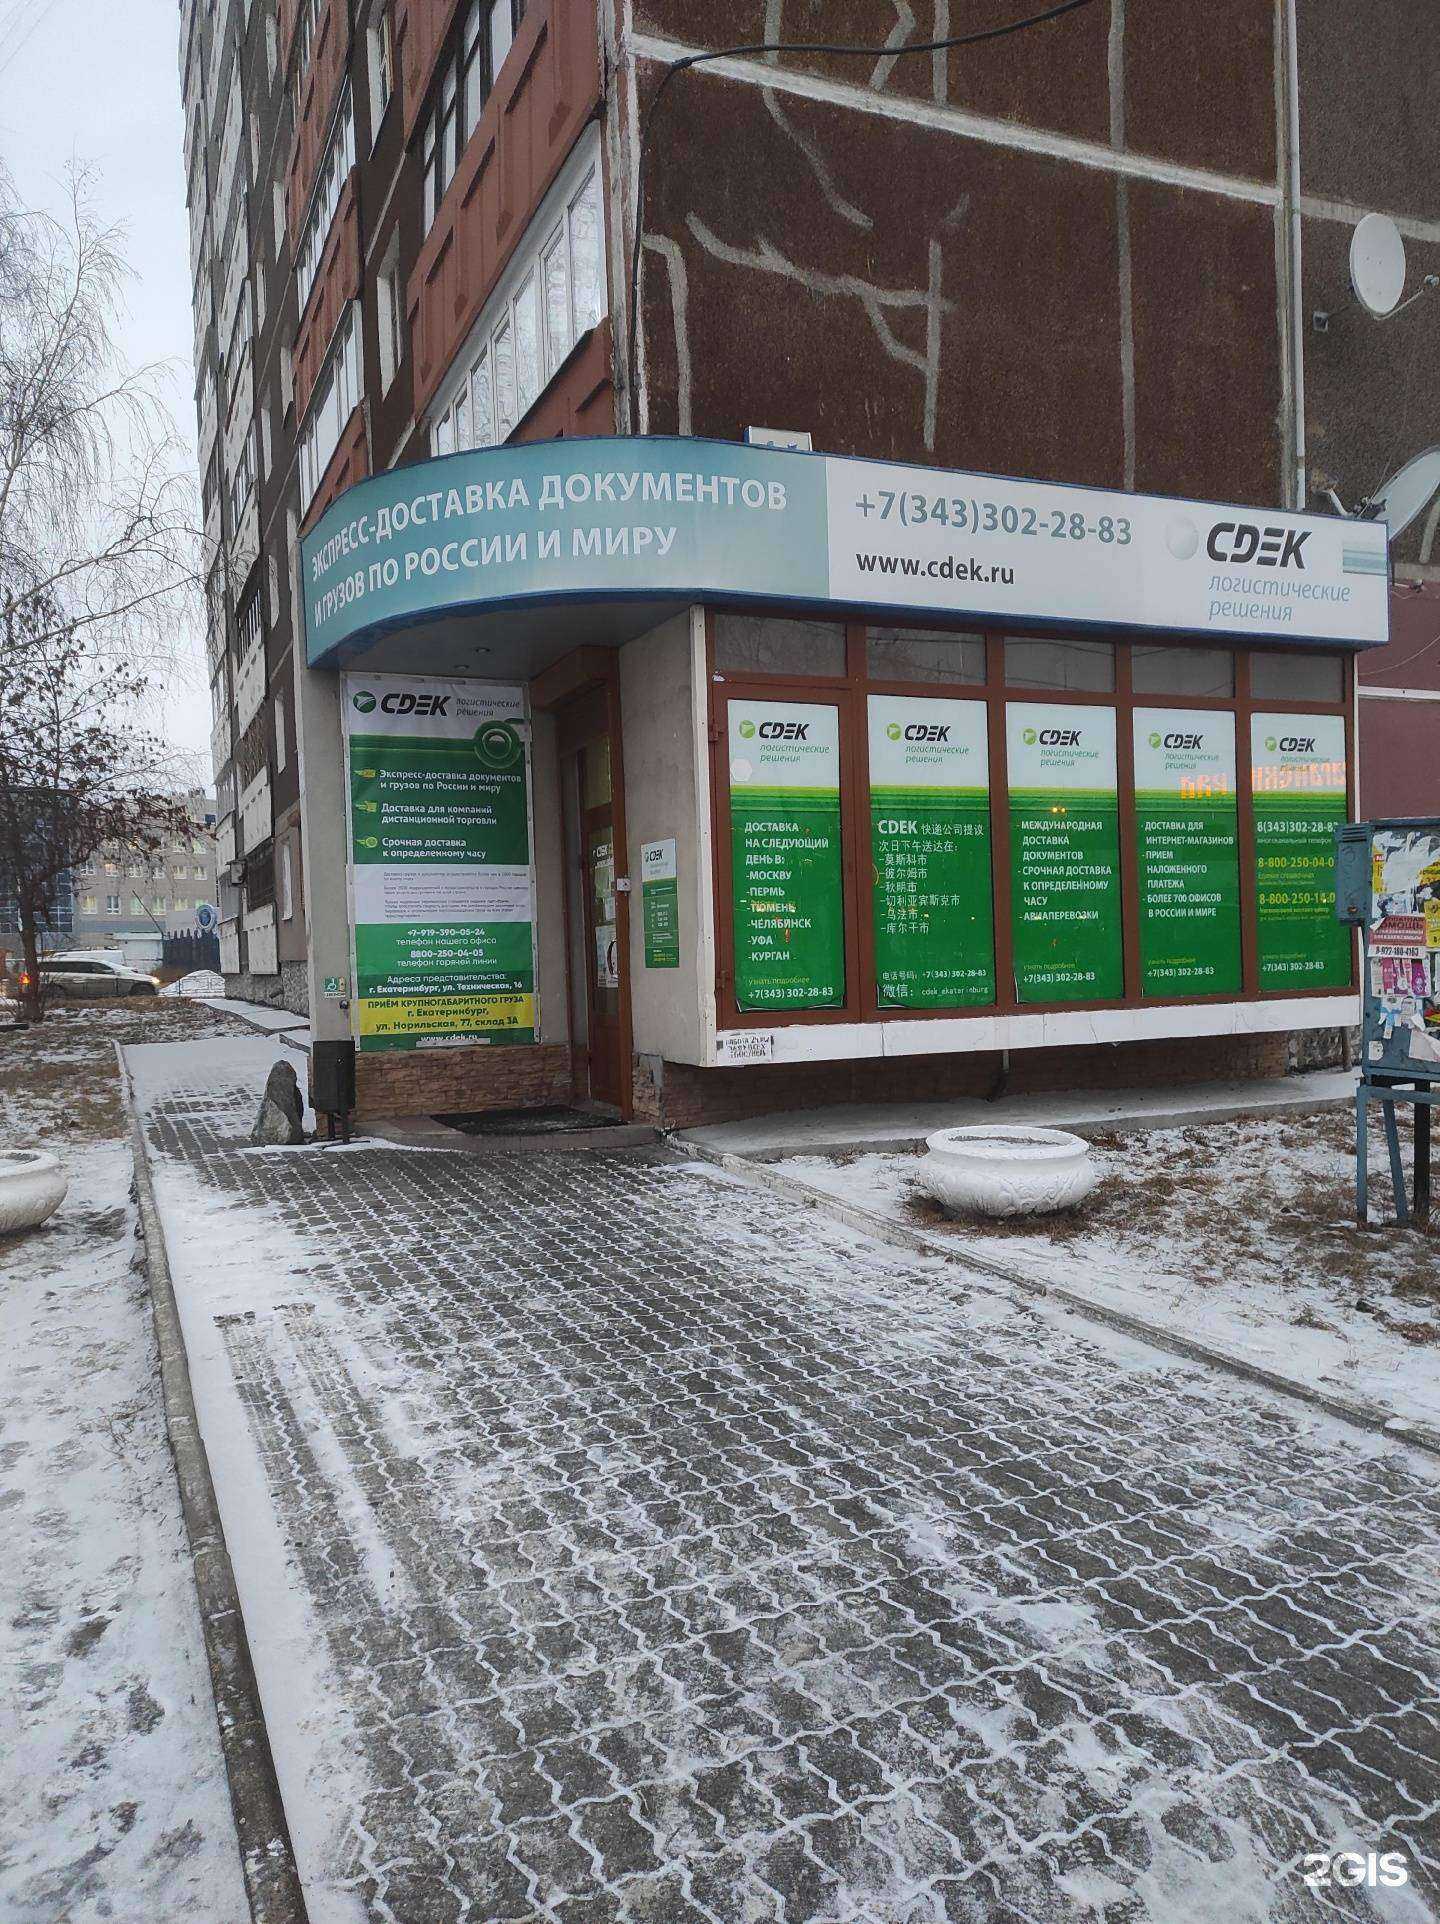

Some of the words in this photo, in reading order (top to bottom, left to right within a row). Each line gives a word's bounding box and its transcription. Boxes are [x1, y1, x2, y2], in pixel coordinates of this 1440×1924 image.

[855, 490, 1132, 545] +7(343)302-28-83
[311, 478, 530, 582] ЭКСПРЕСС-ДОСТАВКА
[538, 472, 788, 511] ДОКУМЕНТОВ
[1206, 522, 1313, 570] CDEK
[856, 552, 1015, 585] www.cdek.ru
[314, 600, 322, 628] И
[322, 570, 365, 622] ГРУЗОВ
[368, 558, 399, 592] ПО
[404, 532, 528, 582] РОССИИ
[537, 529, 561, 559] И
[572, 526, 678, 556] МИРУ
[1209, 574, 1352, 603] логистические
[1209, 599, 1293, 622] решения
[380, 693, 452, 717] CDEK
[758, 721, 811, 741] CDEK
[904, 724, 952, 742] CDEK
[1039, 729, 1082, 746] CDEK
[1163, 733, 1204, 750] CDEK
[1279, 737, 1316, 753] CDEK
[379, 769, 466, 780] Экспресс-доставка
[469, 772, 522, 783] документов
[389, 782, 420, 791] грузов
[437, 781, 469, 791] России
[479, 784, 501, 794] миру
[381, 803, 426, 814] Доставка
[427, 805, 445, 815] для
[447, 804, 493, 814] компаний
[381, 814, 455, 825] дистанционной
[456, 816, 497, 826] торговли
[744, 822, 800, 833] ДОСТАВКА
[878, 819, 918, 835] CDEK
[1187, 821, 1204, 832] ДЛЯ
[381, 837, 423, 848] Срочная
[424, 838, 467, 848] доставка
[745, 838, 760, 848] НА
[761, 837, 829, 850] СЛЕДУЮЩИЙ
[1022, 835, 1070, 846] ДОСТАВКА
[1146, 835, 1234, 846] ИНТЕРНЕТ-МАГАЗИНОВ
[390, 849, 465, 859] определенному
[466, 849, 487, 859] часу
[745, 854, 774, 865] ДЕНЬ
[774, 854, 785, 865] В:
[1022, 850, 1084, 862] ДОКУМЕНТОВ
[1065, 865, 1112, 876] ДОСТАВКА
[1146, 864, 1208, 875] НАЛОЖЕННОГО
[1023, 881, 1030, 891] К
[1031, 880, 1109, 892] ОПРЕДЕЛЕННОМУ
[1147, 879, 1185, 889] ПЛАТЕЖА
[1023, 896, 1048, 906] ЧАСУ
[1173, 893, 1188, 903] 700
[1188, 893, 1222, 903] ОФИСОВ
[1148, 908, 1154, 918] В
[1155, 908, 1187, 918] РОССИИ
[1195, 907, 1217, 917] МИРЕ
[396, 937, 433, 947] телефон
[435, 937, 469, 946] нашего
[470, 937, 497, 946] офиса
[397, 958, 434, 968] телефон
[435, 957, 471, 967] горячей
[472, 957, 498, 966] линии
[1055, 971, 1096, 982] 302-28-83
[443, 984, 455, 993] ул.
[513, 981, 523, 989] 16
[748, 988, 785, 1000] +7(343)
[786, 986, 834, 998] 302-28-83
[367, 997, 399, 1009] ПРИЁМ
[401, 996, 498, 1008] КРУПНОГАБАРИТНОГО
[499, 995, 525, 1004] ГРУЗА
[416, 1006, 489, 1018] Екатеринбург,
[375, 1022, 391, 1032] ул.
[393, 1020, 458, 1031] Норильская,
[474, 1017, 505, 1027] склад
